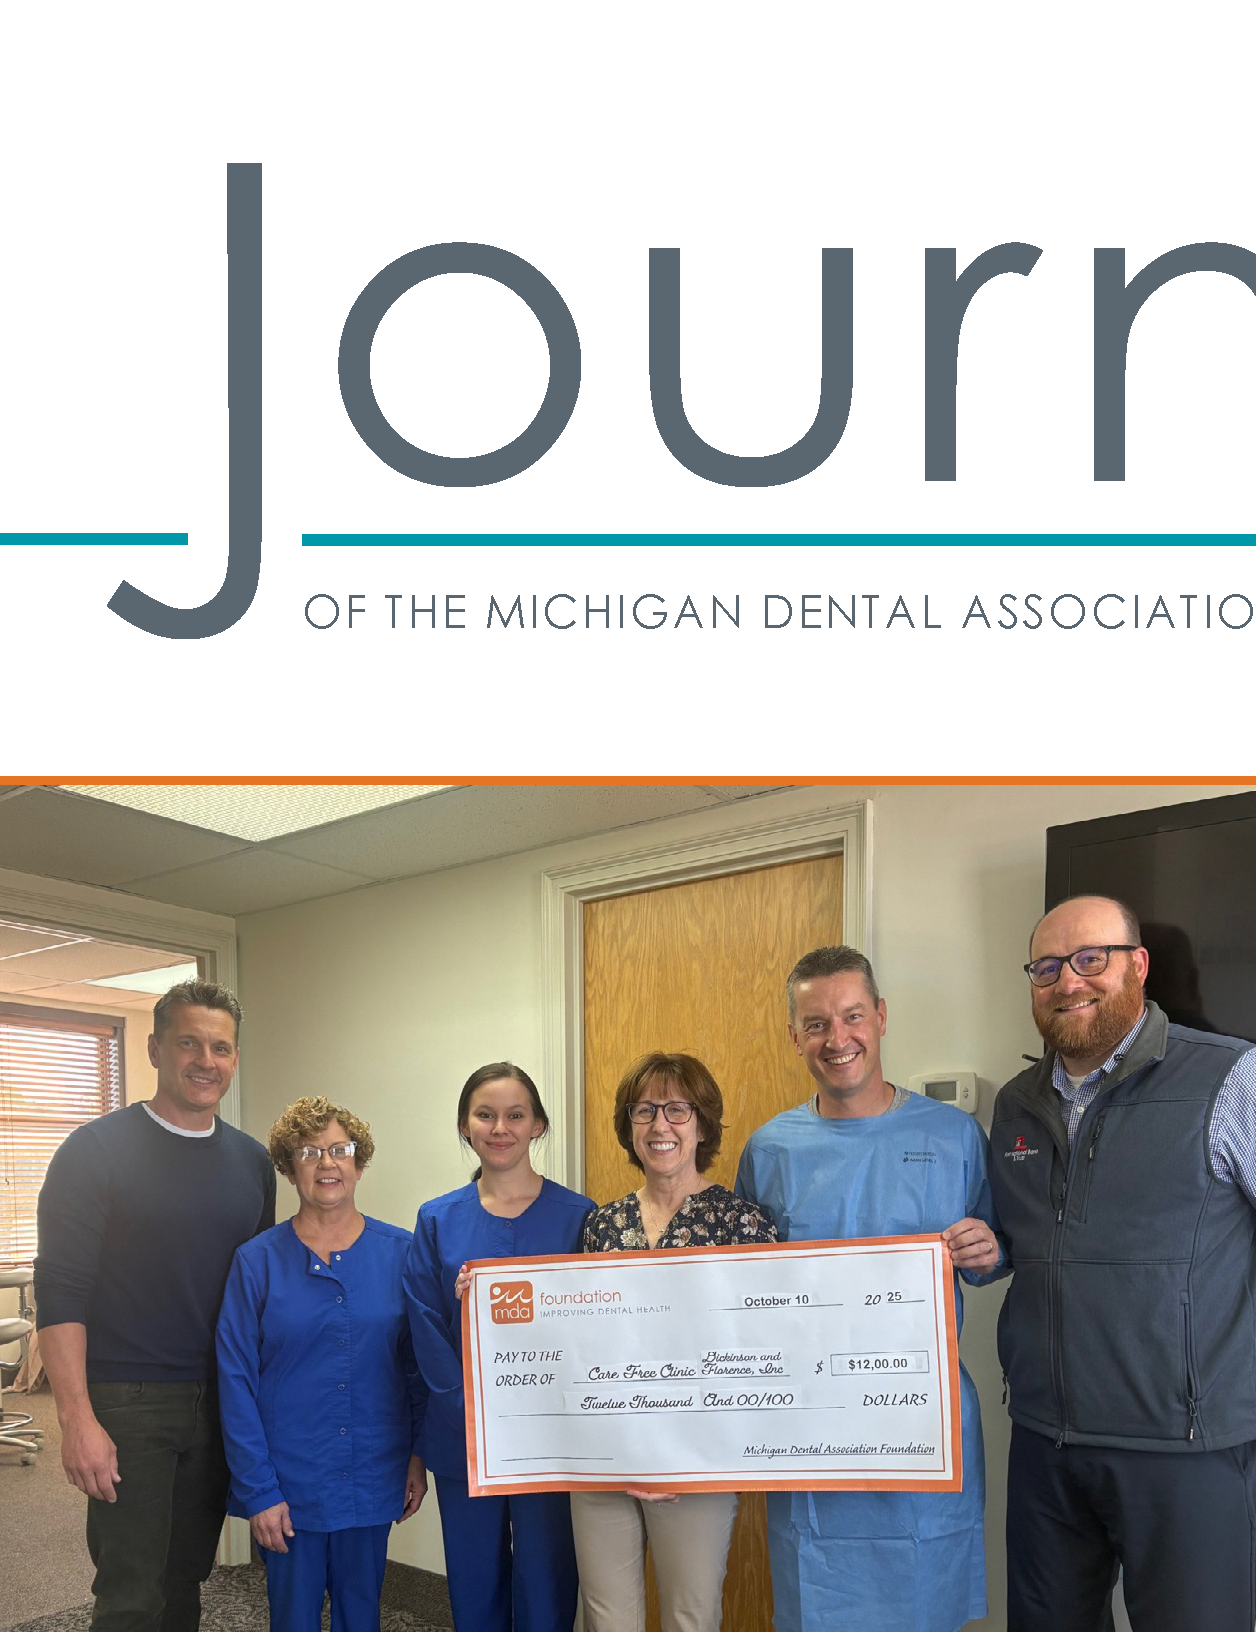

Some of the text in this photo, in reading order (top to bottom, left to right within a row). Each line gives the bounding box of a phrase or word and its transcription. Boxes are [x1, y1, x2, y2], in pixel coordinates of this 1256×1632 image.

[540, 1290, 621, 1305] foundation
[744, 1297, 791, 1307] October
[795, 1295, 809, 1304] 10
[495, 1303, 530, 1319] mda
[540, 1309, 594, 1318] IMPROVING
[598, 1307, 634, 1315] DENTAL
[494, 1351, 563, 1363] PAY TO THE
[760, 1352, 781, 1360] and
[588, 1363, 696, 1380] Care Free Clinic
[701, 1363, 783, 1375] Florence, Inc
[814, 1358, 908, 1374] $ $12,00.00
[496, 1374, 555, 1387] ORDER OF
[581, 1395, 693, 1410] Twelve Thousand
[863, 1393, 927, 1406] DOLLARS
[744, 1442, 935, 1459] Michigan Dental Association Foundation
